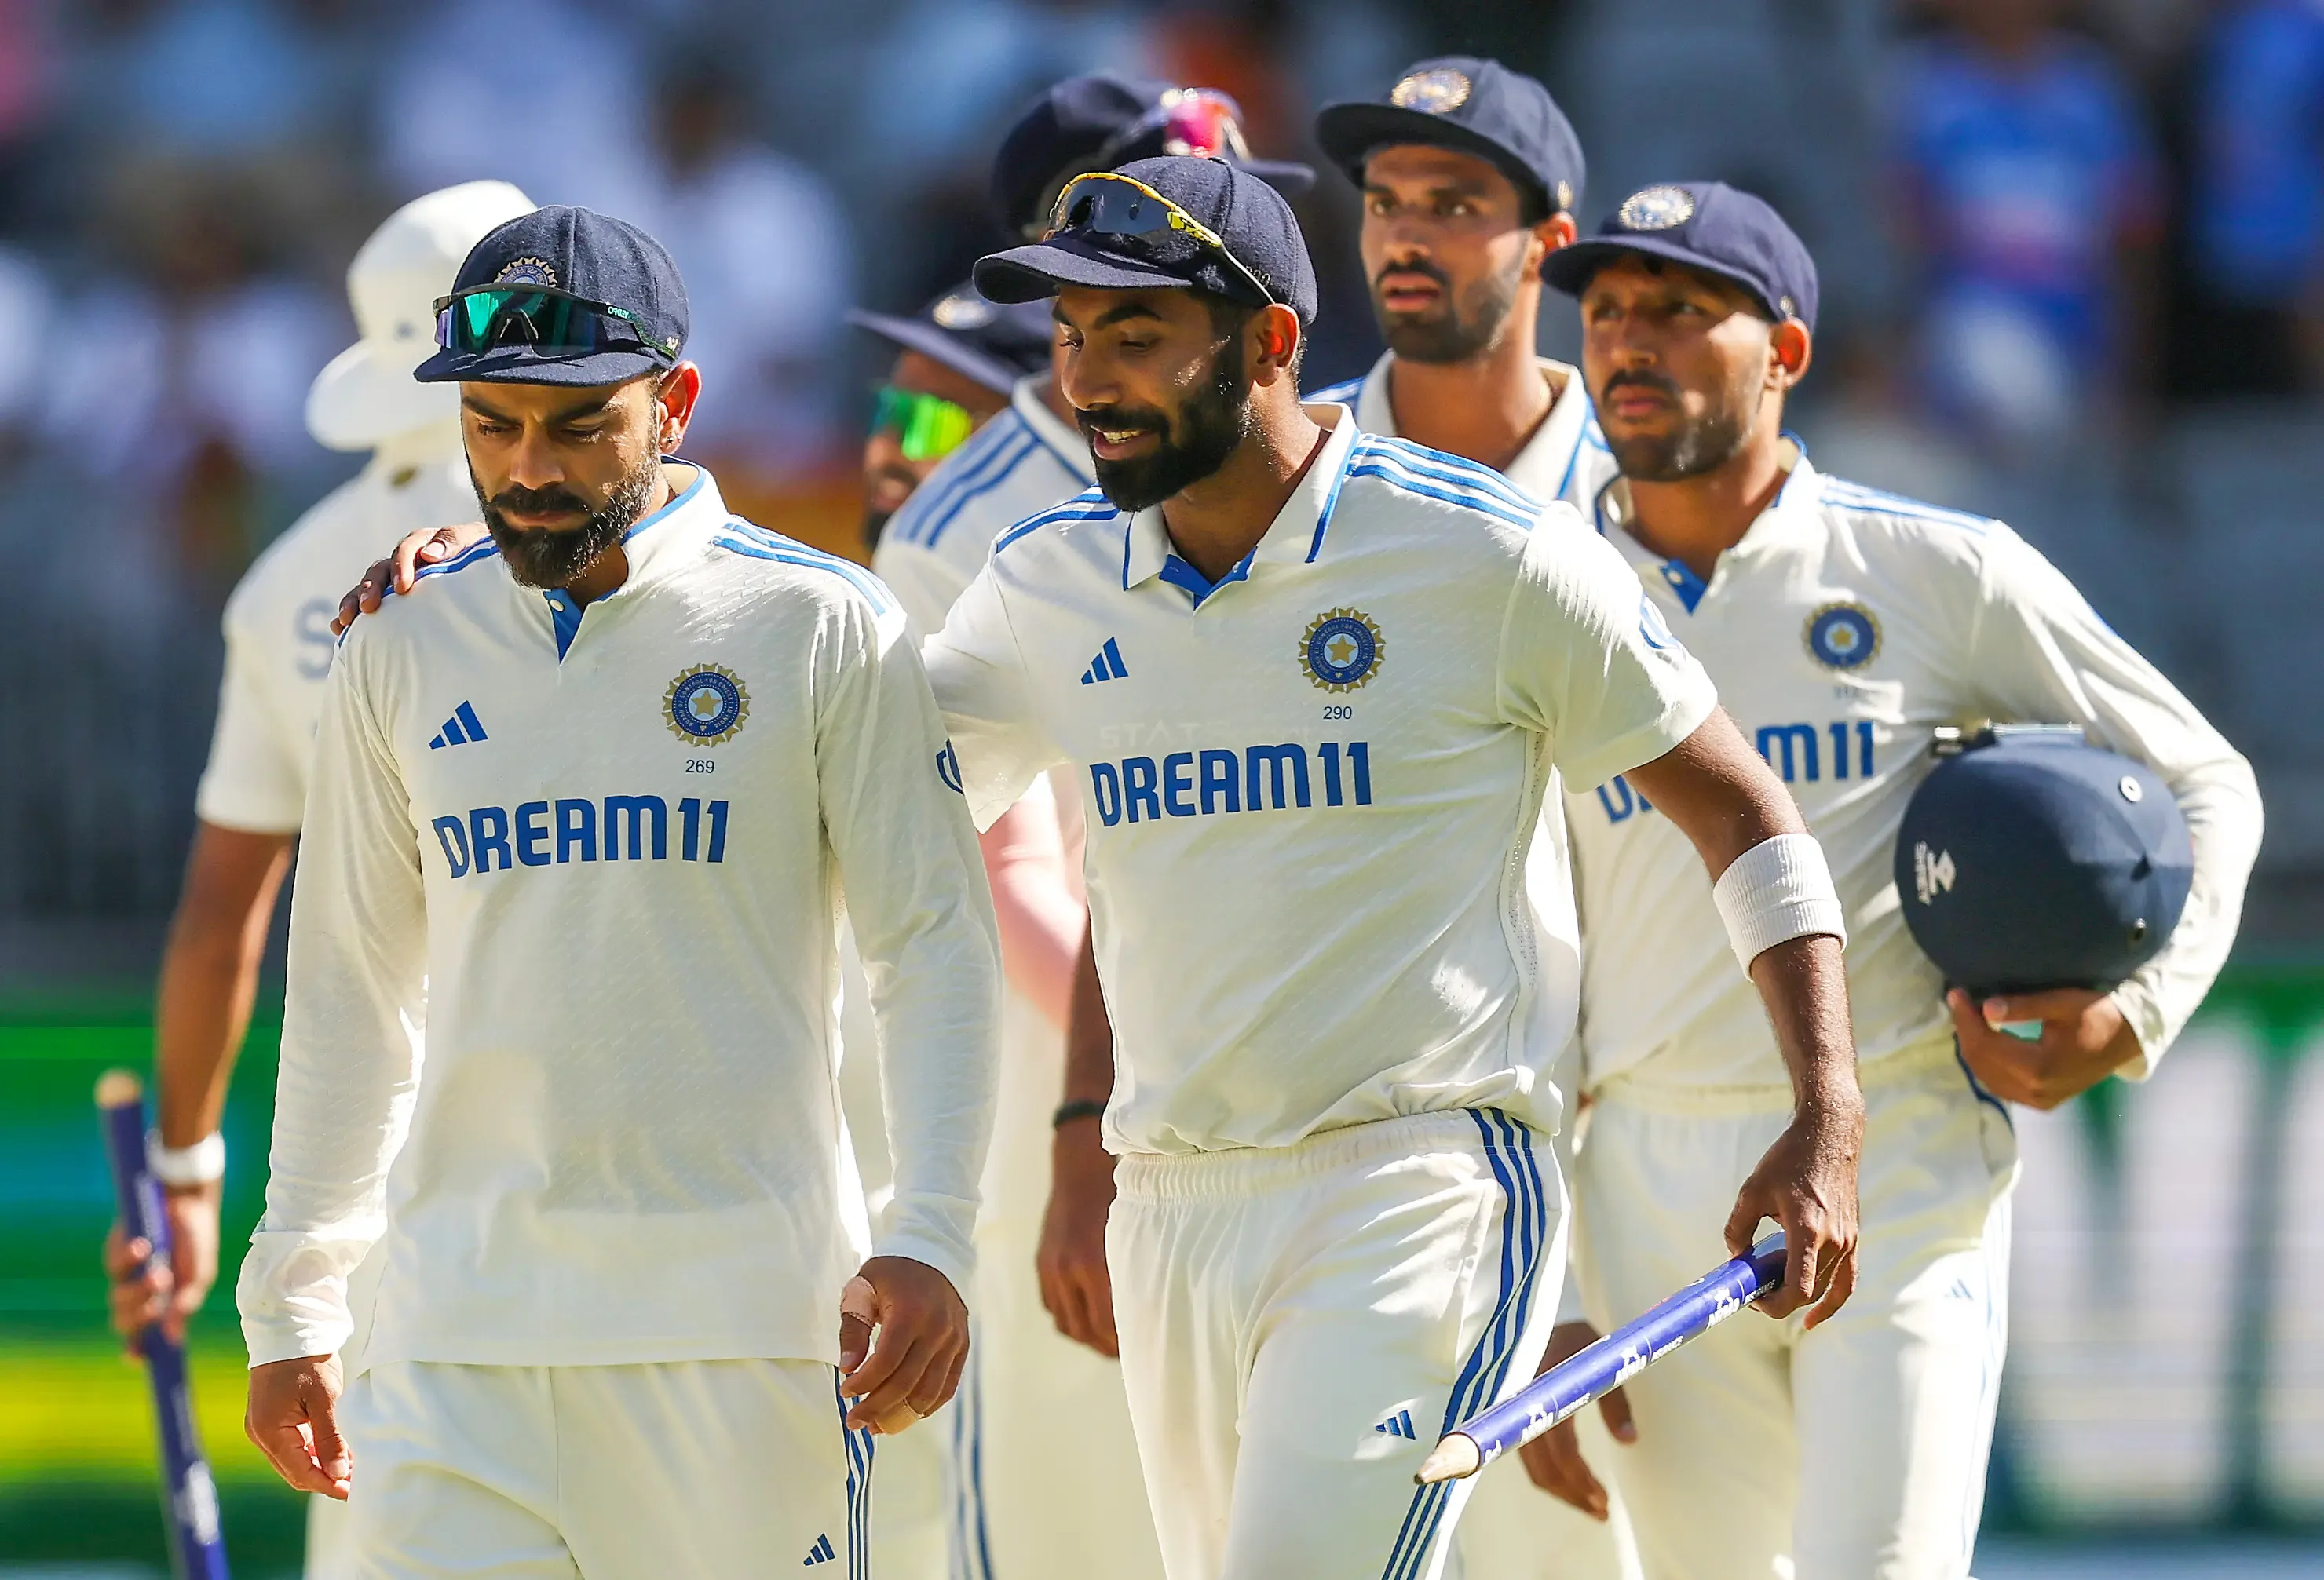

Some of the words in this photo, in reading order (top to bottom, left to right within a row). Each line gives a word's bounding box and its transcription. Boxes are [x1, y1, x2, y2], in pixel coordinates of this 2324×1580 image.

[1323, 706, 1352, 720] 290
[685, 760, 714, 773] 269
[1090, 742, 1372, 827] DREAM11
[431, 795, 729, 879] DREAM11
